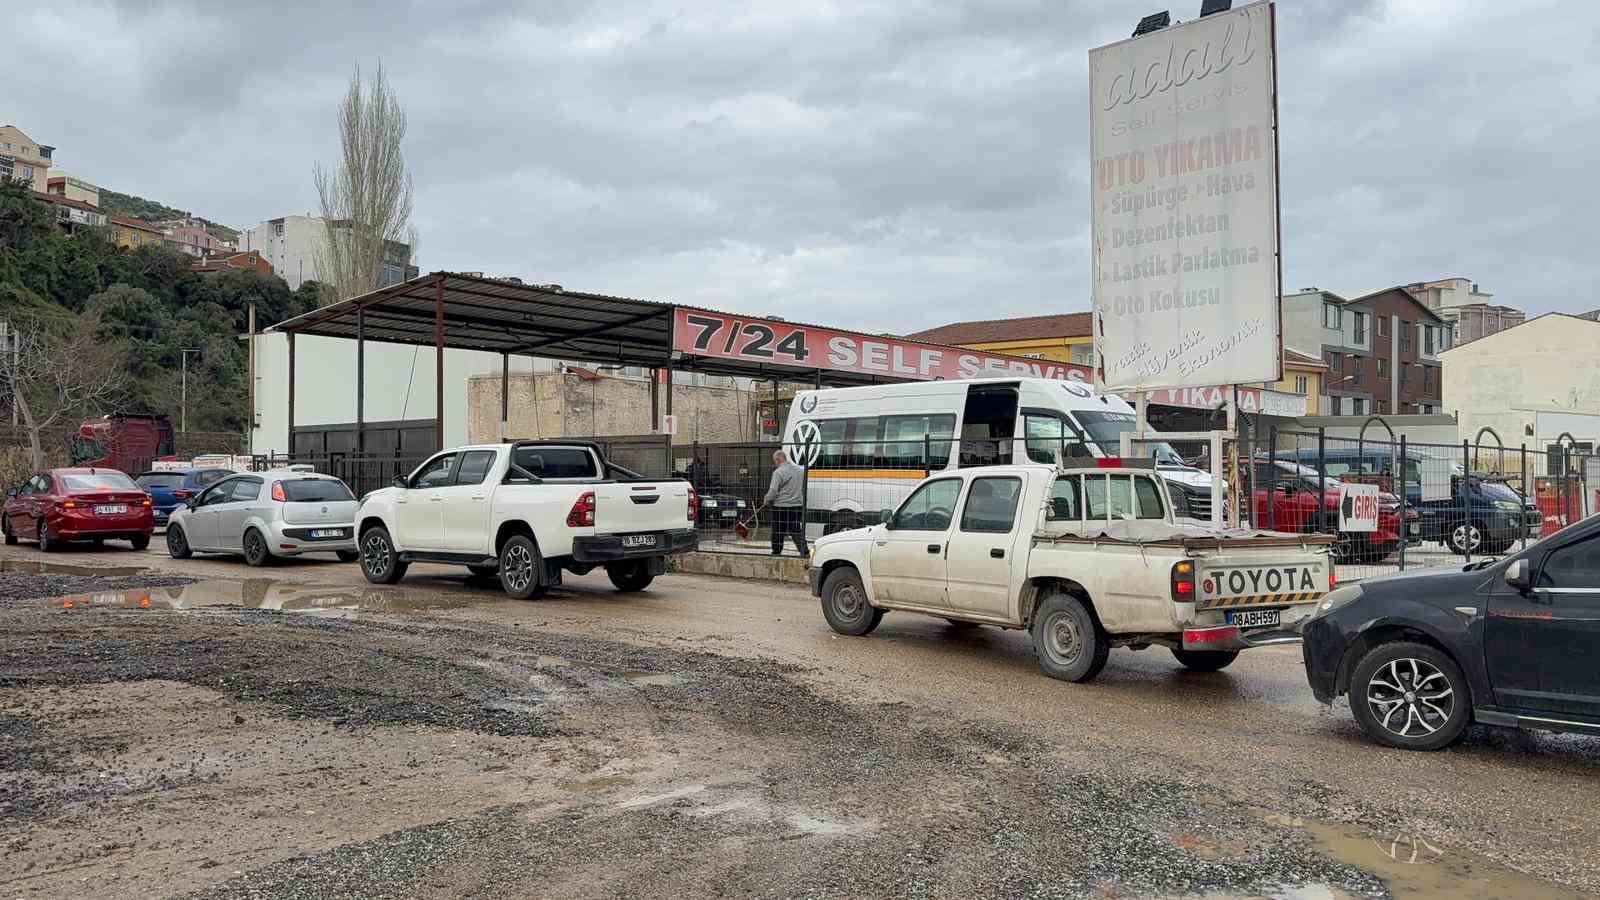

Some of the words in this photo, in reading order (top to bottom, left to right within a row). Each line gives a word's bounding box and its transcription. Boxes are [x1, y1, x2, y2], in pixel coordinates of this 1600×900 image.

[1096, 150, 1146, 192] OTO
[1152, 127, 1265, 178] YIKAMA
[1111, 185, 1189, 217] Süpürge
[1112, 214, 1230, 249] Dezenfektan
[1112, 253, 1168, 283] Lastik
[1171, 245, 1260, 275] Parlatma
[1113, 296, 1145, 318] Oto
[1150, 287, 1220, 313] Kokusu
[686, 314, 809, 361] 7/24
[827, 336, 944, 375] SELF
[666, 416, 673, 433] 1
[1211, 568, 1315, 594] TOYOTA
